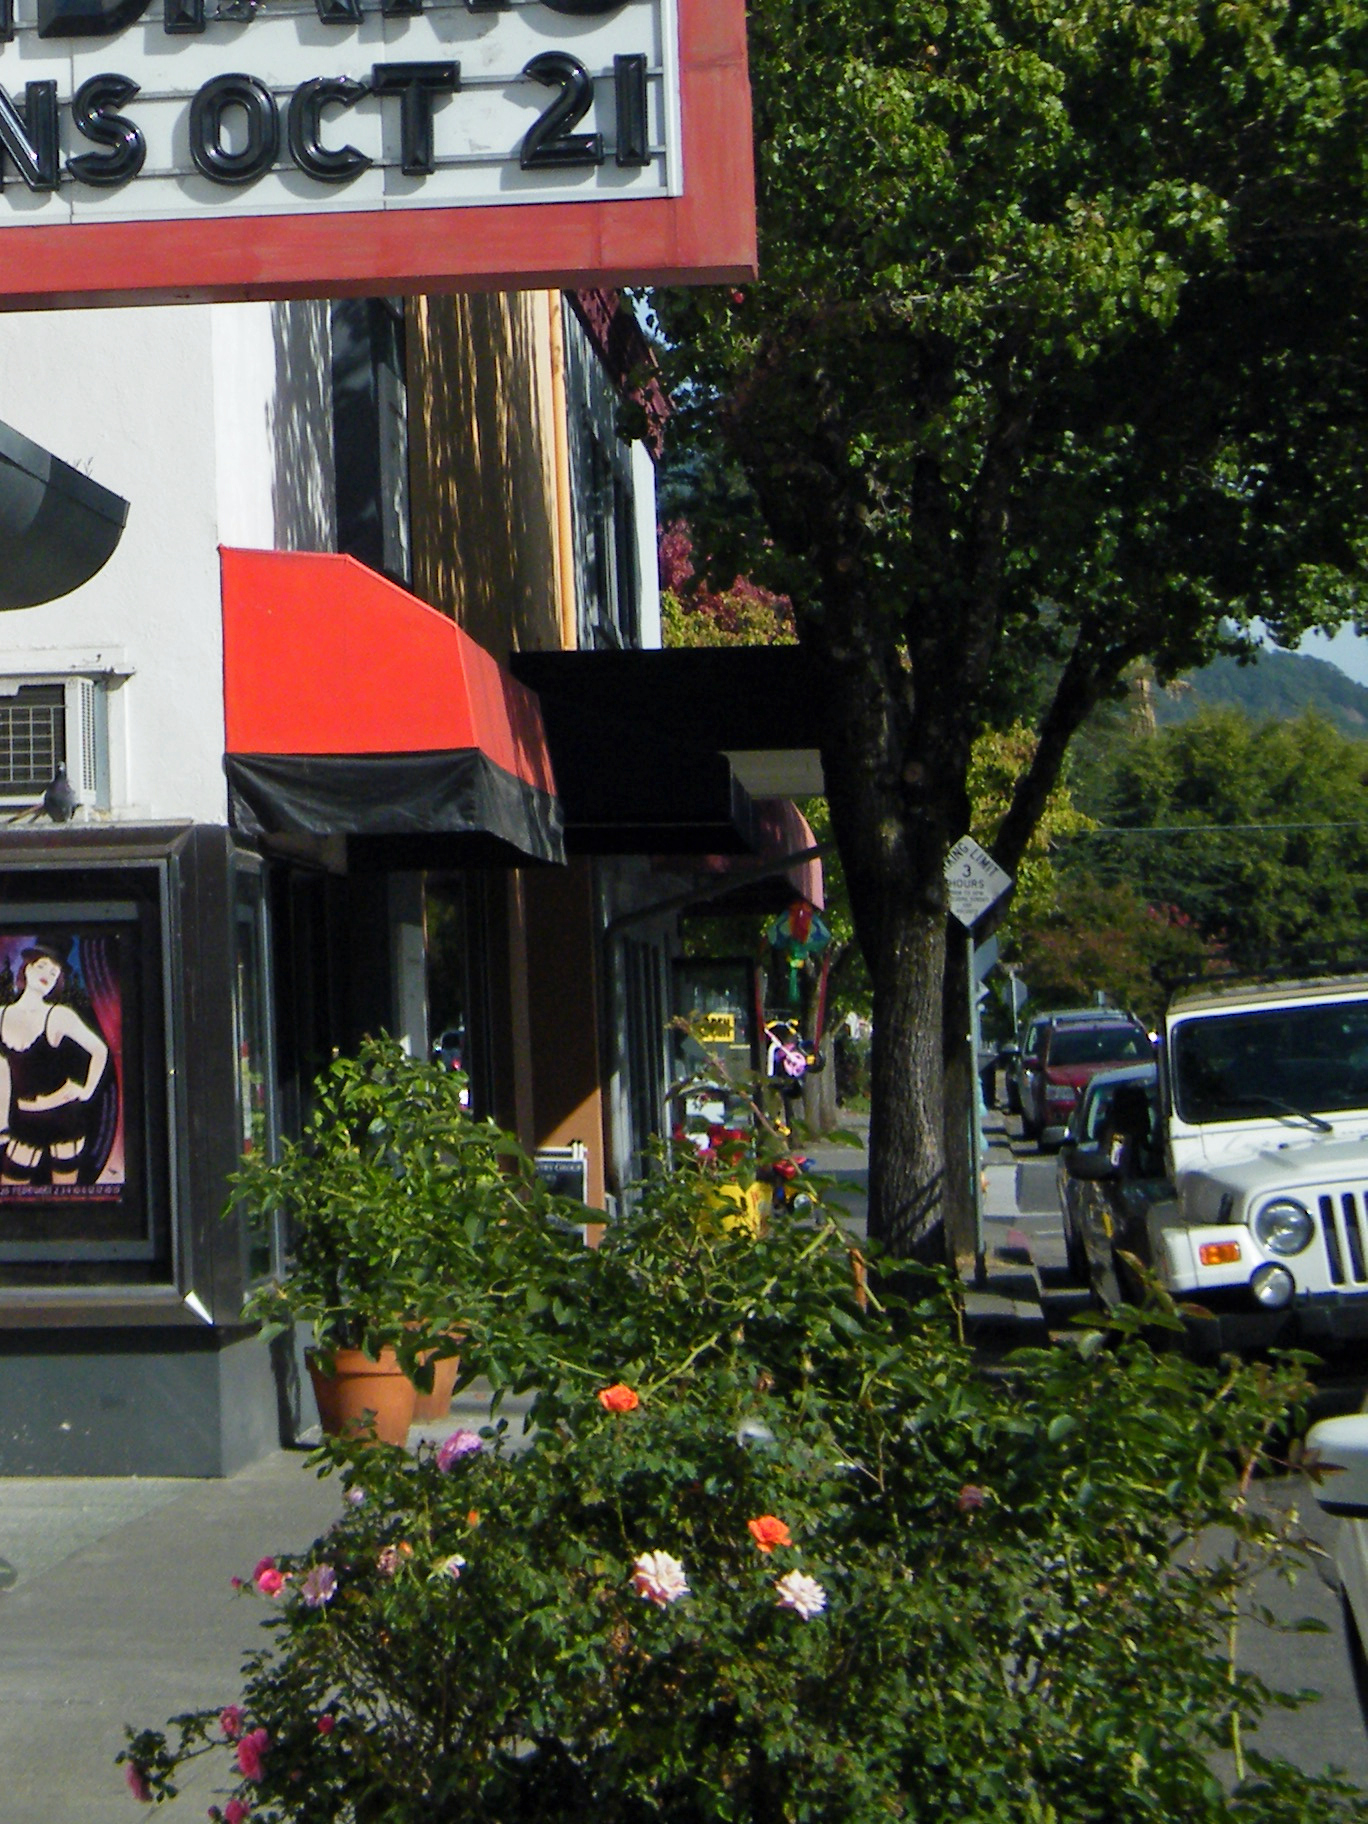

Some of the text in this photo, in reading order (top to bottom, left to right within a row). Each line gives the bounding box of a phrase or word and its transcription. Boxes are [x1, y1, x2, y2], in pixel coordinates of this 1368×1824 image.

[187, 59, 462, 183] OCT
[521, 49, 650, 170] 21
[961, 863, 972, 878] 3
[970, 848, 1000, 877] LIMIT
